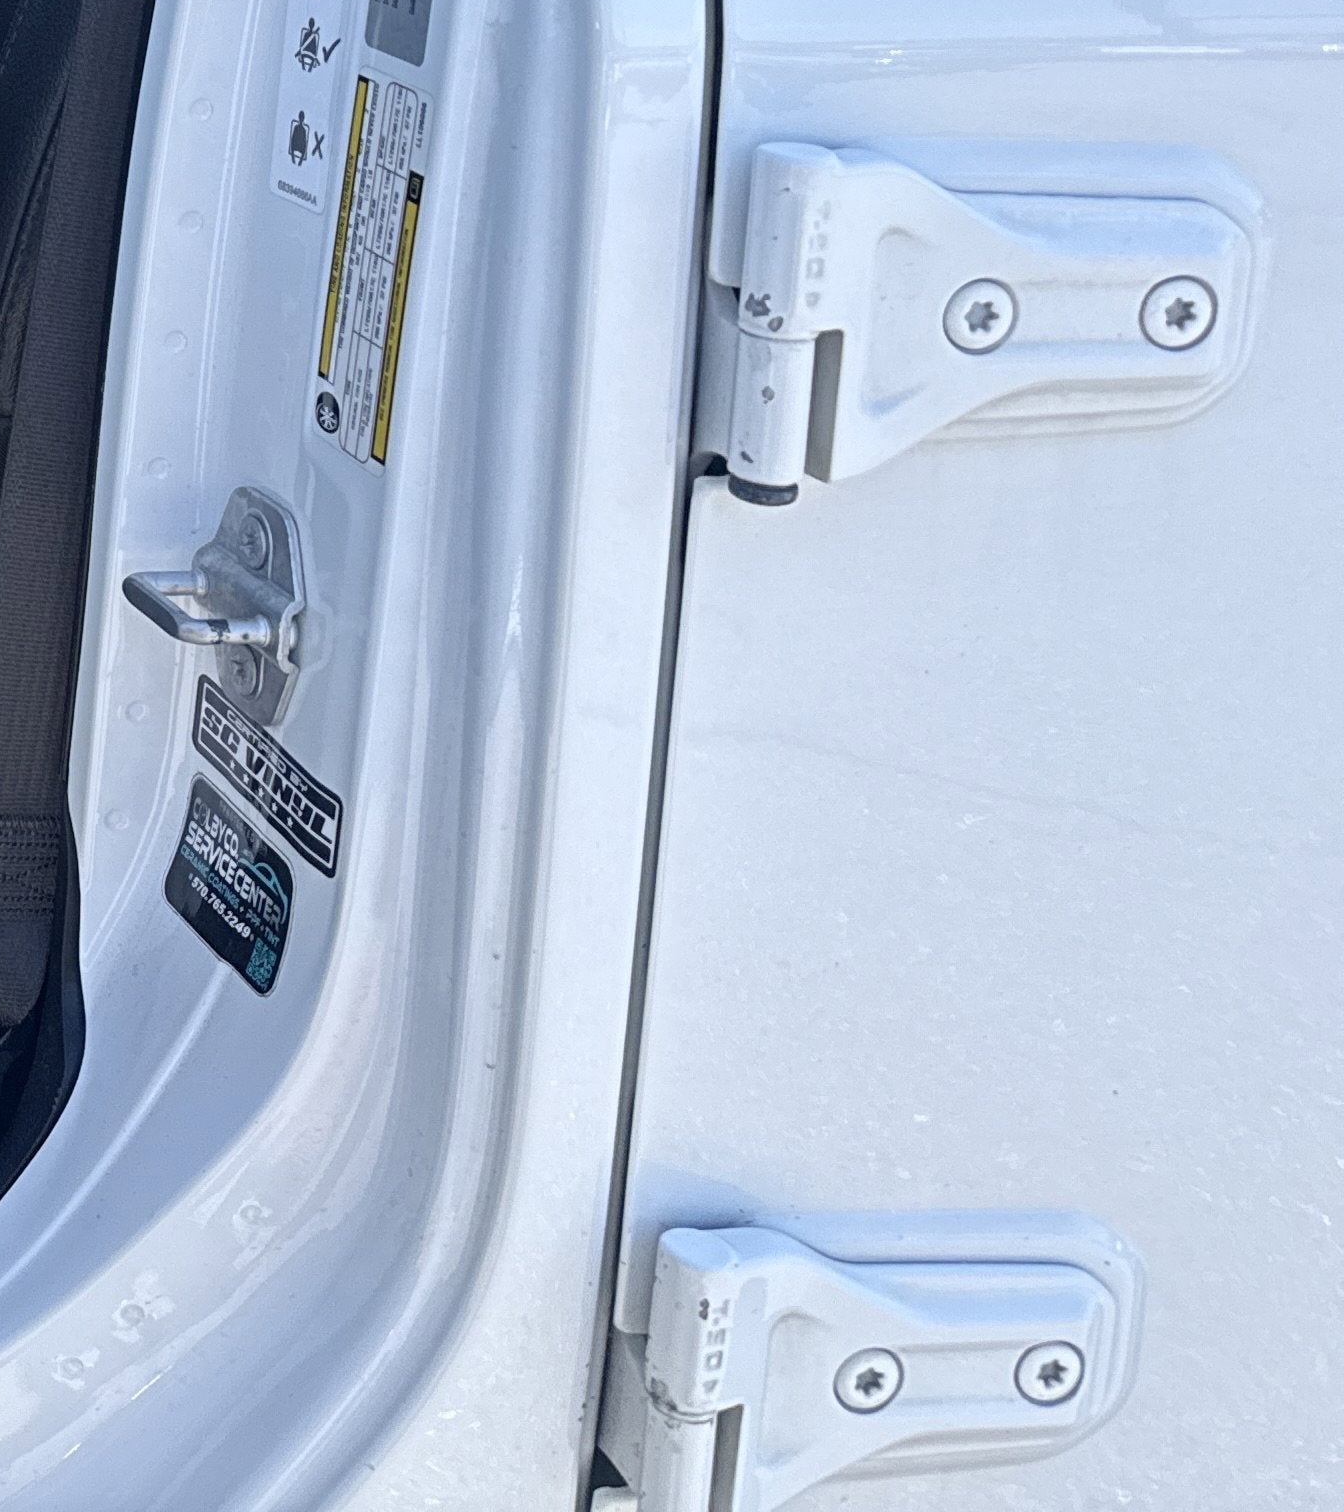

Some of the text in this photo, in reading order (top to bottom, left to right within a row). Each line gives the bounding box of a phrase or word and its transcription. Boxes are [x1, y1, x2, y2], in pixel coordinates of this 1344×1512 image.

[202, 706, 239, 757] SC
[244, 749, 331, 841] VINYL
[226, 710, 309, 792] CERTIFIED BY
[185, 819, 235, 886] SERVICE
[233, 868, 283, 932] CENTER
[190, 876, 251, 940] 570.765.2249
